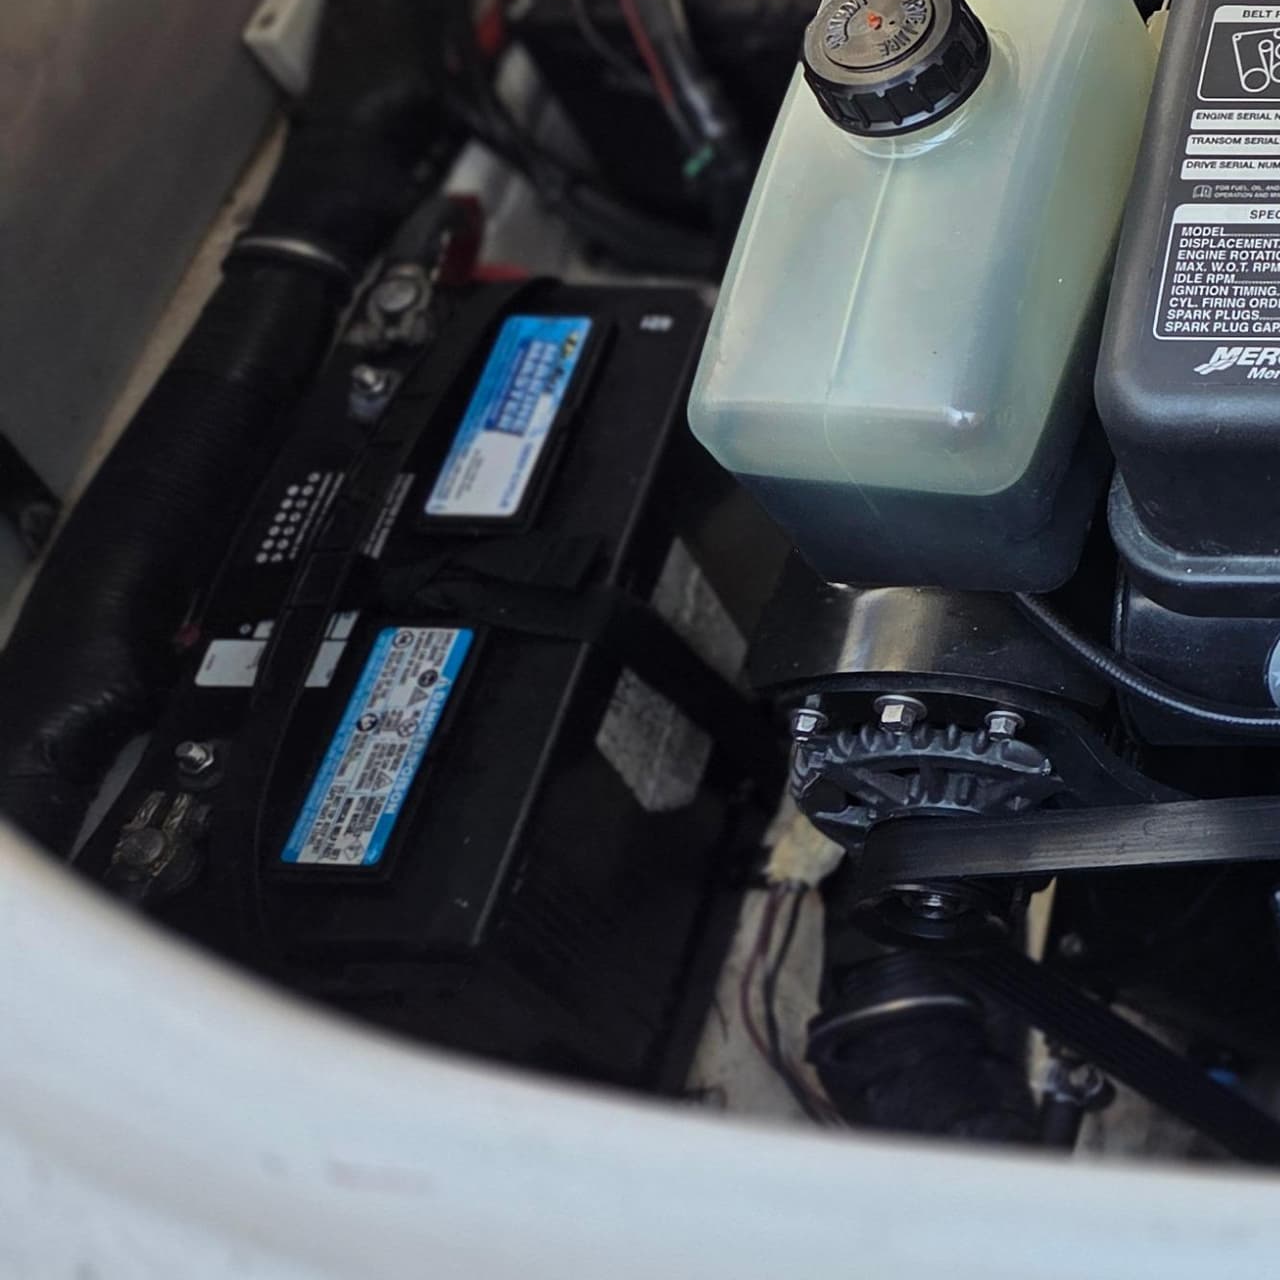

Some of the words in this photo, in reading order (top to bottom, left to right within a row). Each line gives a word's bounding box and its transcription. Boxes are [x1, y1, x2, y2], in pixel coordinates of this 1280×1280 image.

[1242, 9, 1272, 19] BELT
[1196, 112, 1235, 121] ENGINE
[1238, 112, 1271, 121] SERIAL
[1191, 137, 1240, 145] TRANSOM
[1244, 137, 1279, 145] SERIAL
[1186, 161, 1217, 170] DRIVE
[1220, 161, 1255, 169] SERIAL
[1177, 251, 1228, 261] ENGINE
[1176, 262, 1208, 272] MAX.
[1211, 262, 1250, 272] W.O.T.
[1173, 274, 1203, 284] IDLE
[1171, 286, 1229, 296] IGNITION
[1169, 298, 1198, 308] CYL.
[1202, 298, 1247, 308] FIRING
[1167, 310, 1209, 320] SPARK
[1164, 322, 1209, 333] SPARK
[1212, 322, 1249, 333] PLUG
